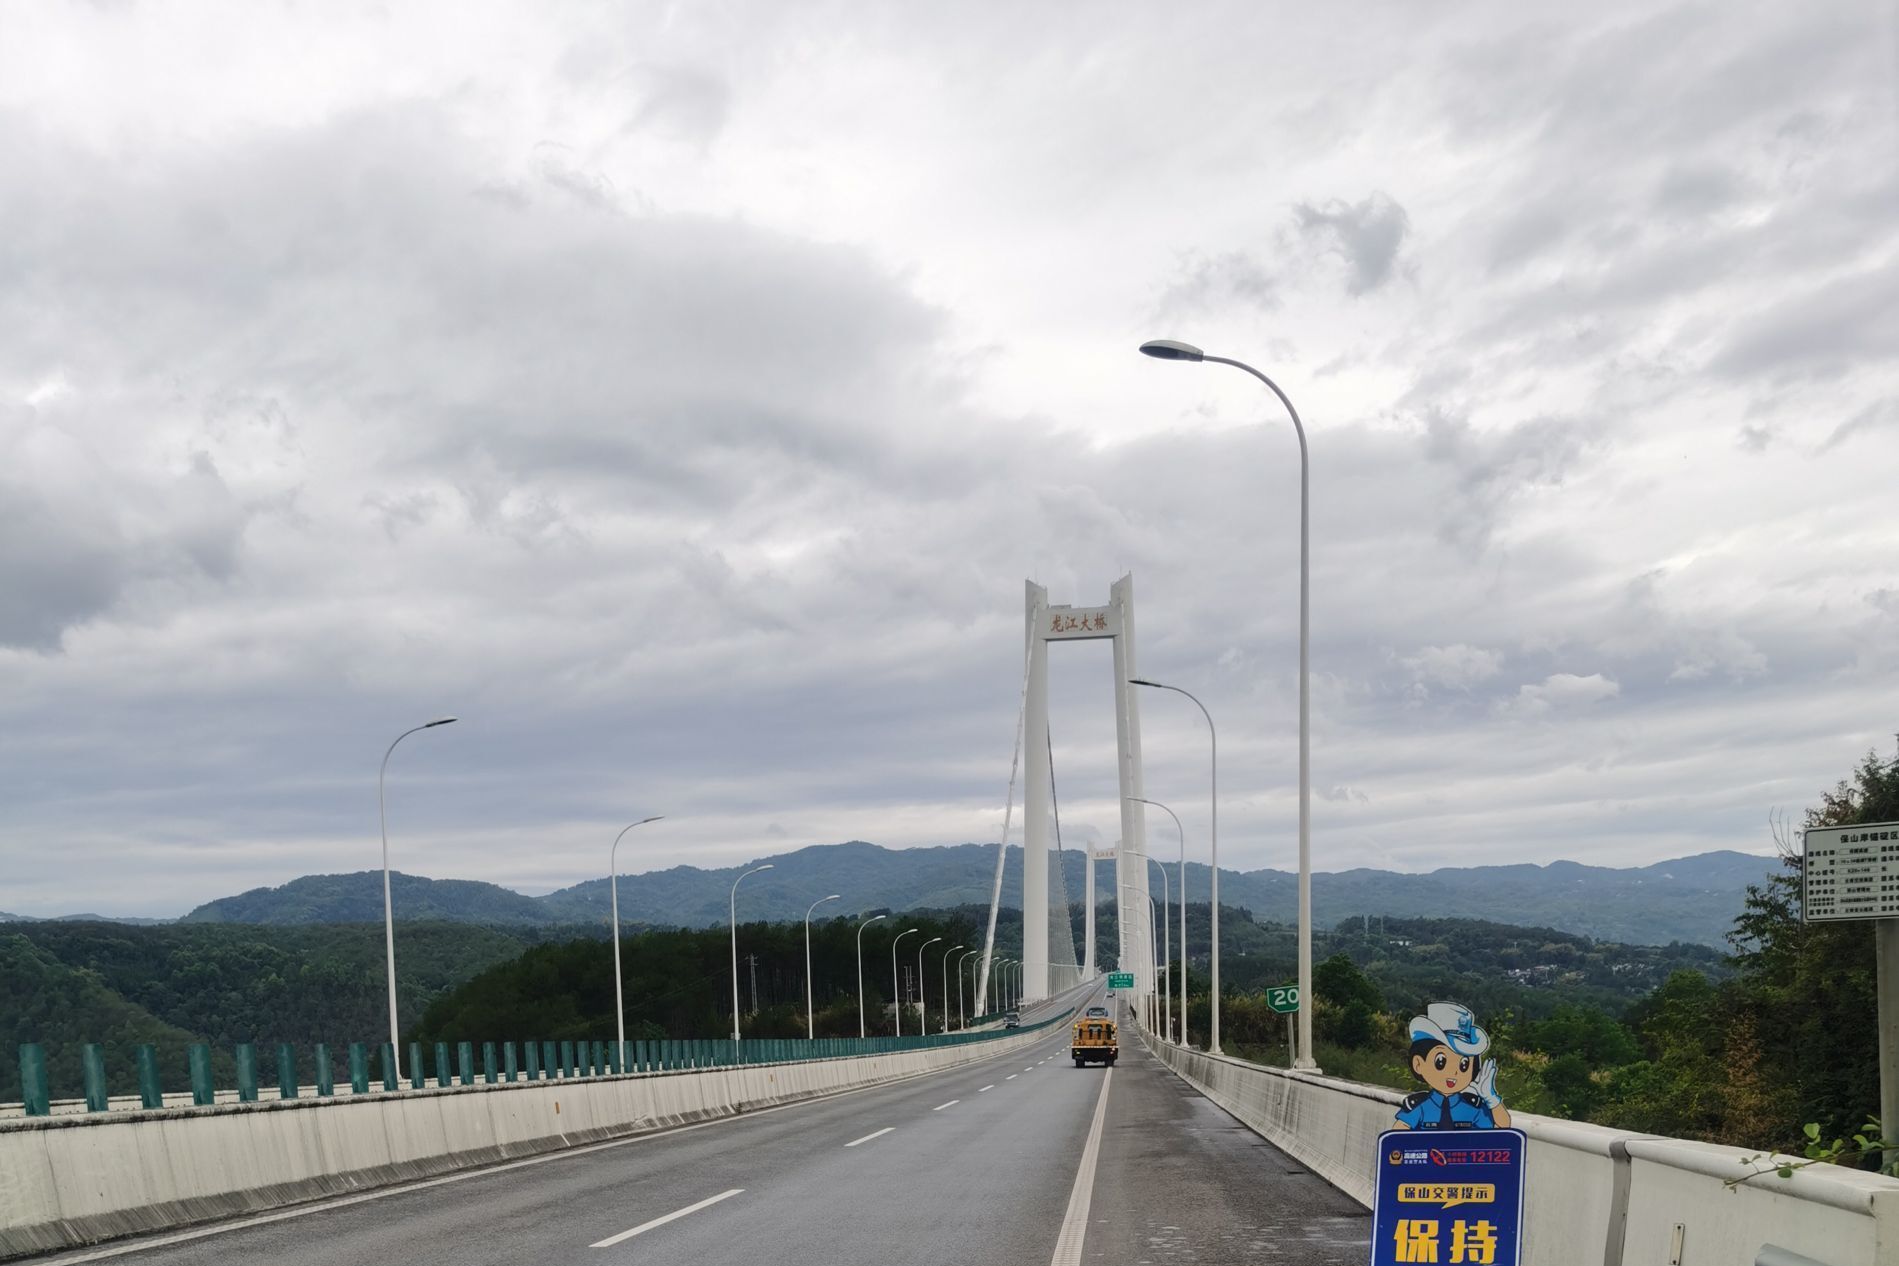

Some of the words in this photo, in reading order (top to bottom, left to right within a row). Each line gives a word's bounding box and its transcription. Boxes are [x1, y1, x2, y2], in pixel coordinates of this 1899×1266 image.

[1051, 612, 1107, 632] 龙江大桥
[1273, 989, 1299, 1006] 20
[1470, 1151, 1510, 1163] 12122
[1404, 1186, 1488, 1199] 保山交警提示
[1393, 1219, 1498, 1264] 保持
